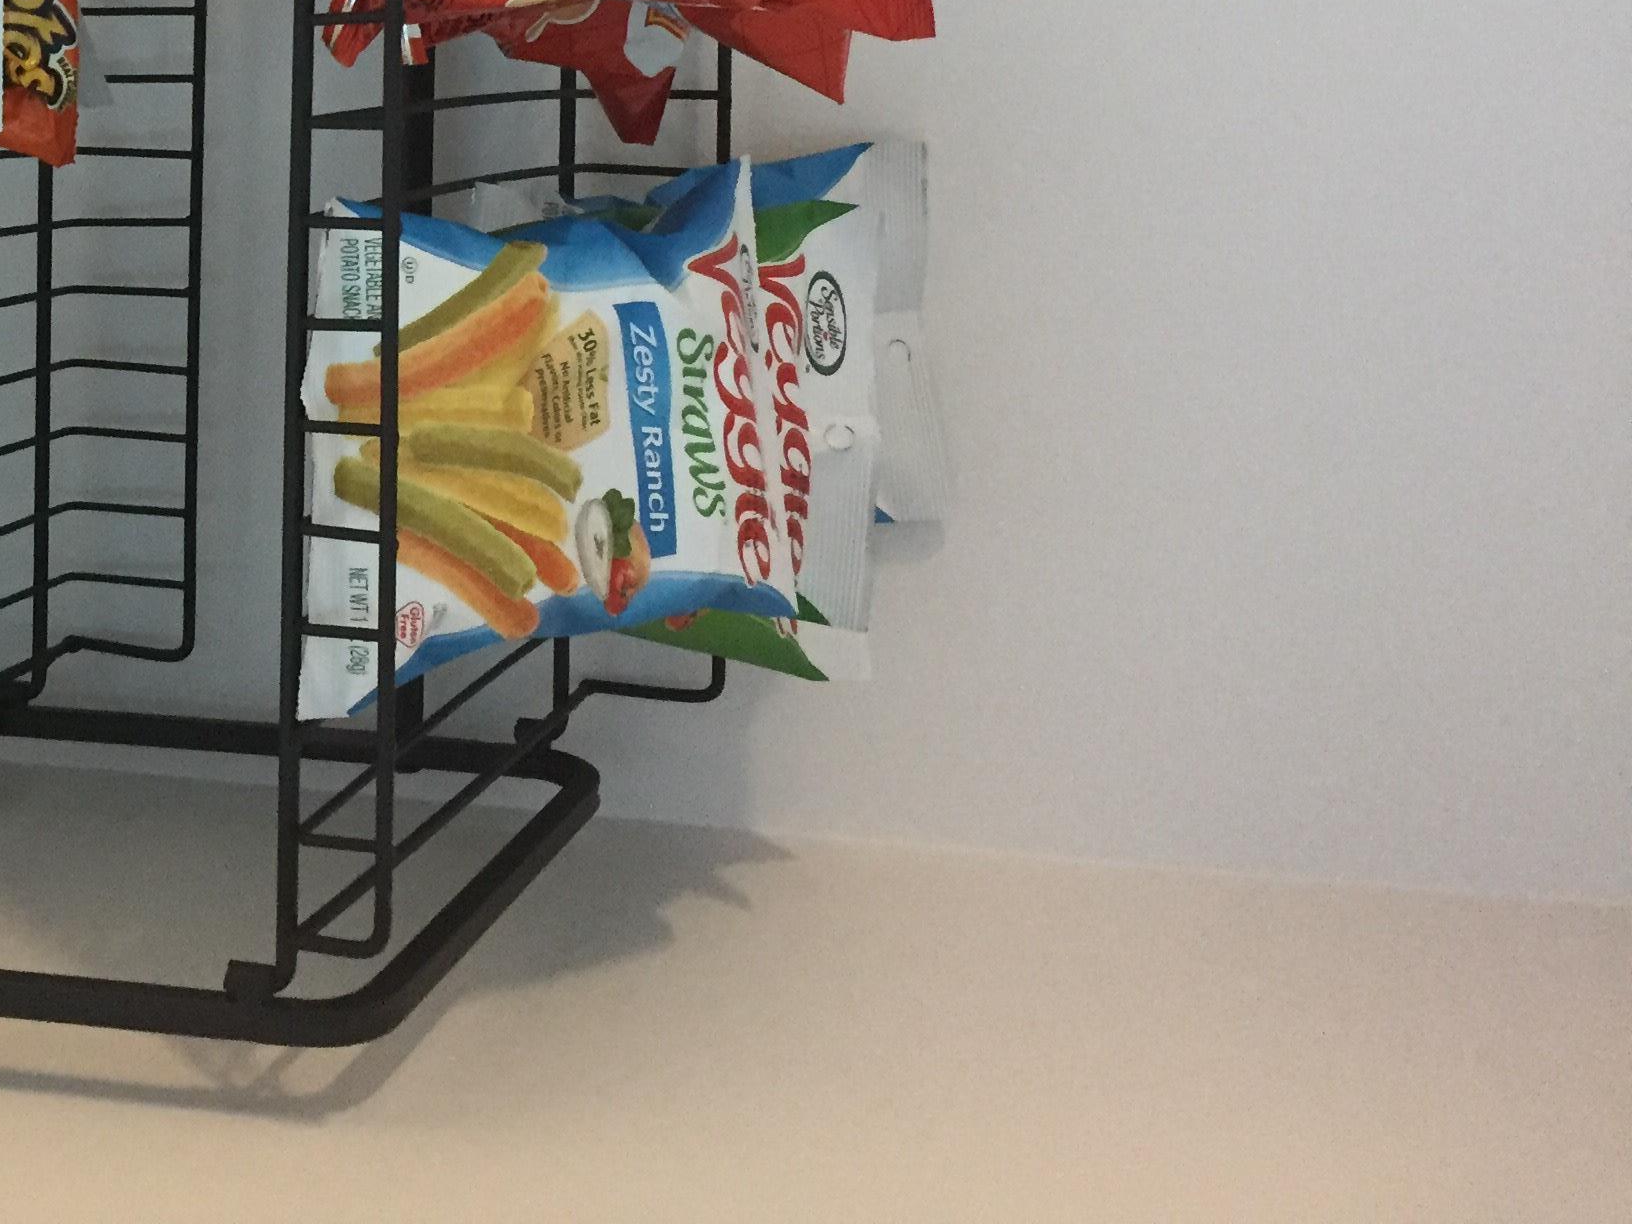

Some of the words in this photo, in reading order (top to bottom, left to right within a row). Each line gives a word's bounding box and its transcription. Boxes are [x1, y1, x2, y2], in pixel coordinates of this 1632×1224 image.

[340, 238, 361, 282] POTATO
[341, 285, 362, 320] SNAC
[821, 286, 844, 351] Sensible
[808, 299, 827, 361] Portions
[584, 368, 597, 400] Less
[629, 323, 660, 416] Zesty
[588, 401, 602, 427] Fat
[675, 326, 727, 519] Straws
[686, 232, 782, 588] Veggie
[641, 426, 669, 533] Ranch
[349, 567, 369, 591] NET
[349, 593, 369, 613] WT
[400, 614, 410, 639] Free
